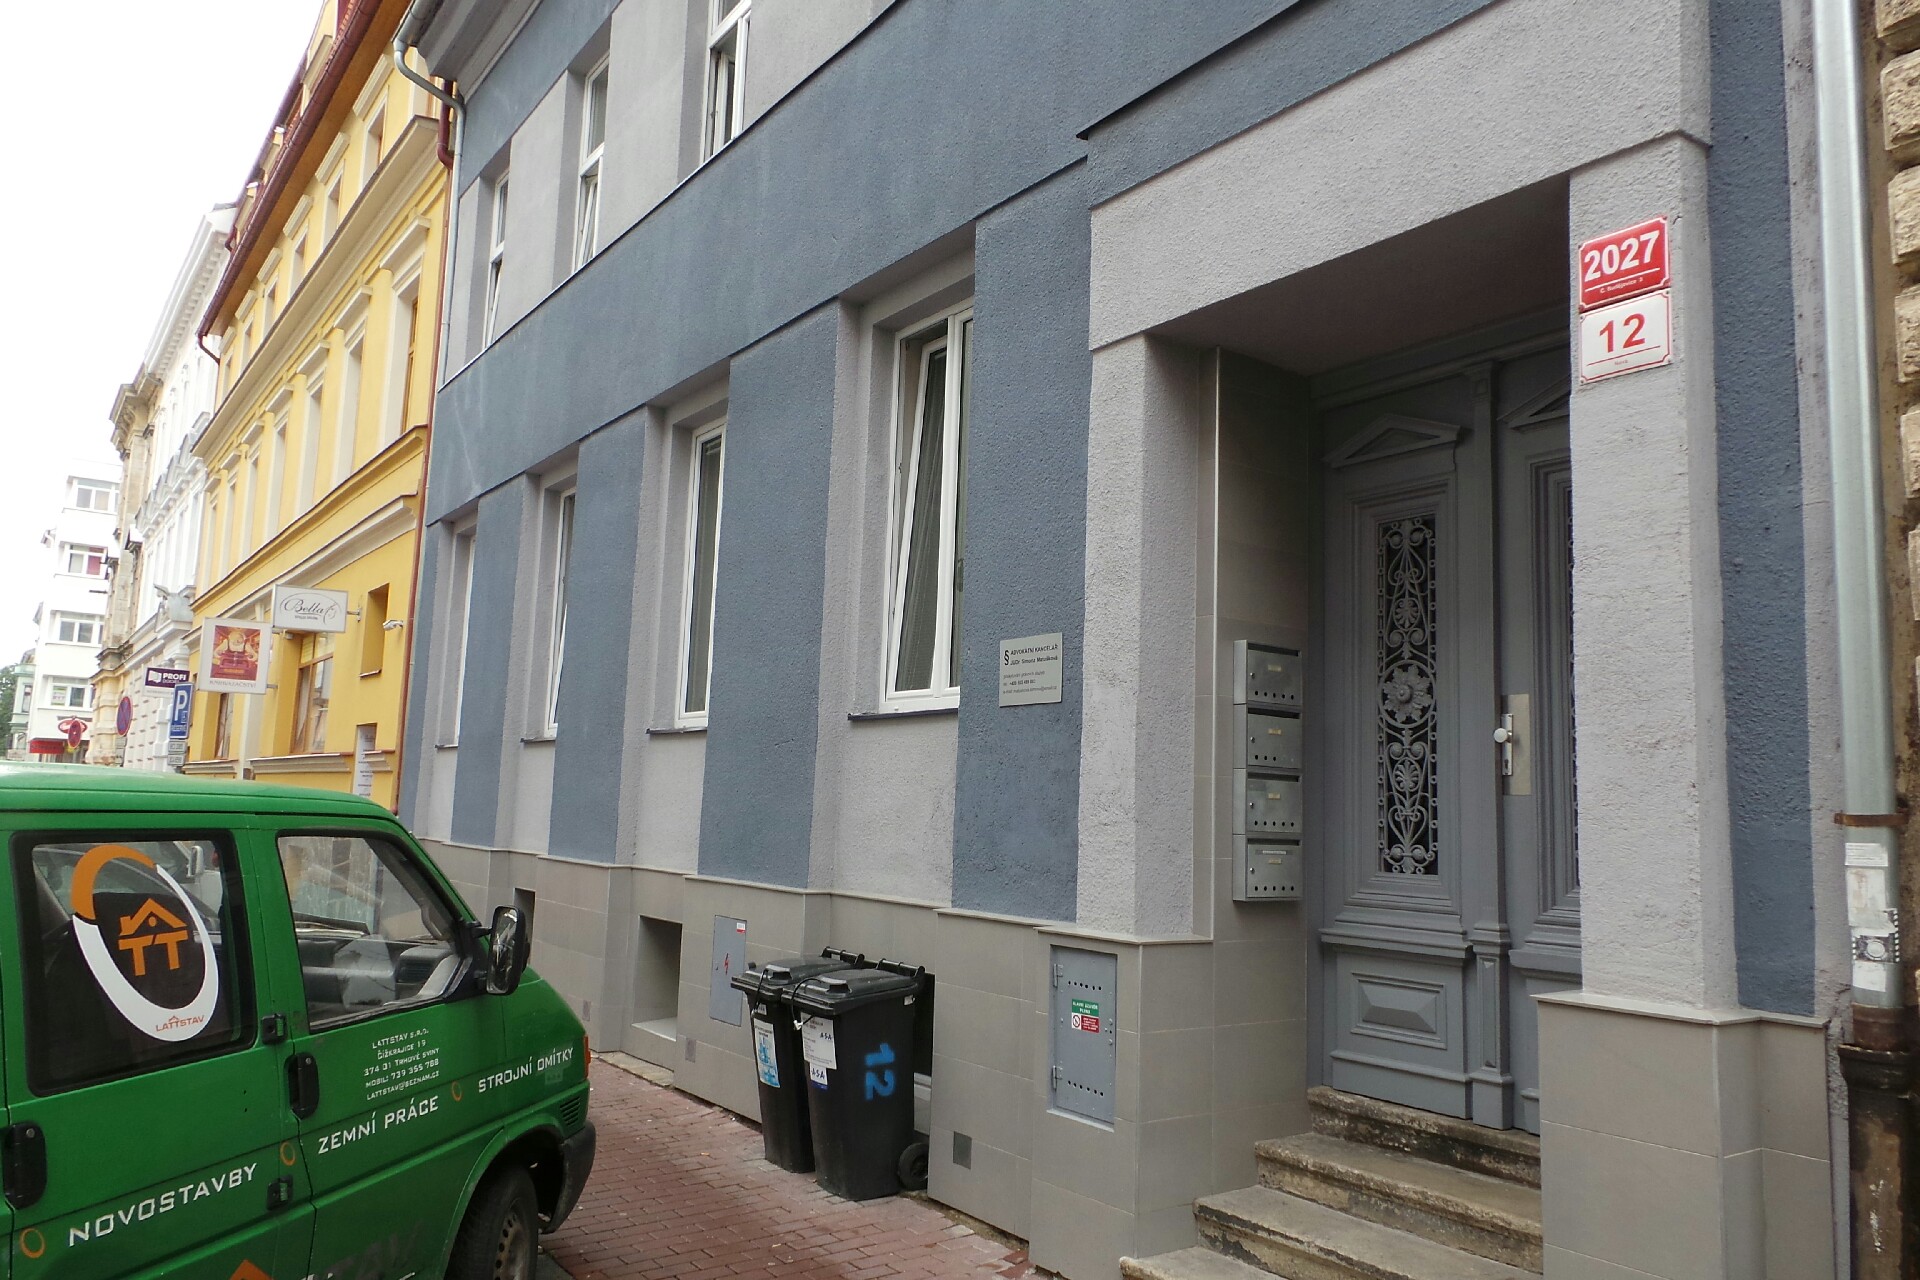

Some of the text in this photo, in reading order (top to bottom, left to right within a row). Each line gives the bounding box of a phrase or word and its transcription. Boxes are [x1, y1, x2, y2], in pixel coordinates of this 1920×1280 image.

[1584, 230, 1660, 282] 2027
[1599, 313, 1646, 353] 12
[284, 598, 324, 613] Bella
[162, 672, 187, 681] PROFI
[175, 690, 188, 721] P
[372, 1032, 408, 1049] LATTSTAV
[417, 1039, 426, 1048] 19
[364, 1065, 380, 1076] 374
[382, 1062, 391, 1070] 01
[394, 1051, 420, 1066] TRHOVÉ
[391, 1069, 406, 1080] 739
[408, 1063, 424, 1075] 355
[537, 1047, 574, 1071] OMÍTKY
[865, 1042, 896, 1100] 12
[366, 1070, 440, 1100] LATTSTAV@SEZNAM.CZ
[478, 1057, 533, 1093] STROJNÍ
[318, 1095, 439, 1155] ZEMNÍ PRÁCE
[68, 1162, 258, 1247] NOVOSTAVBY
